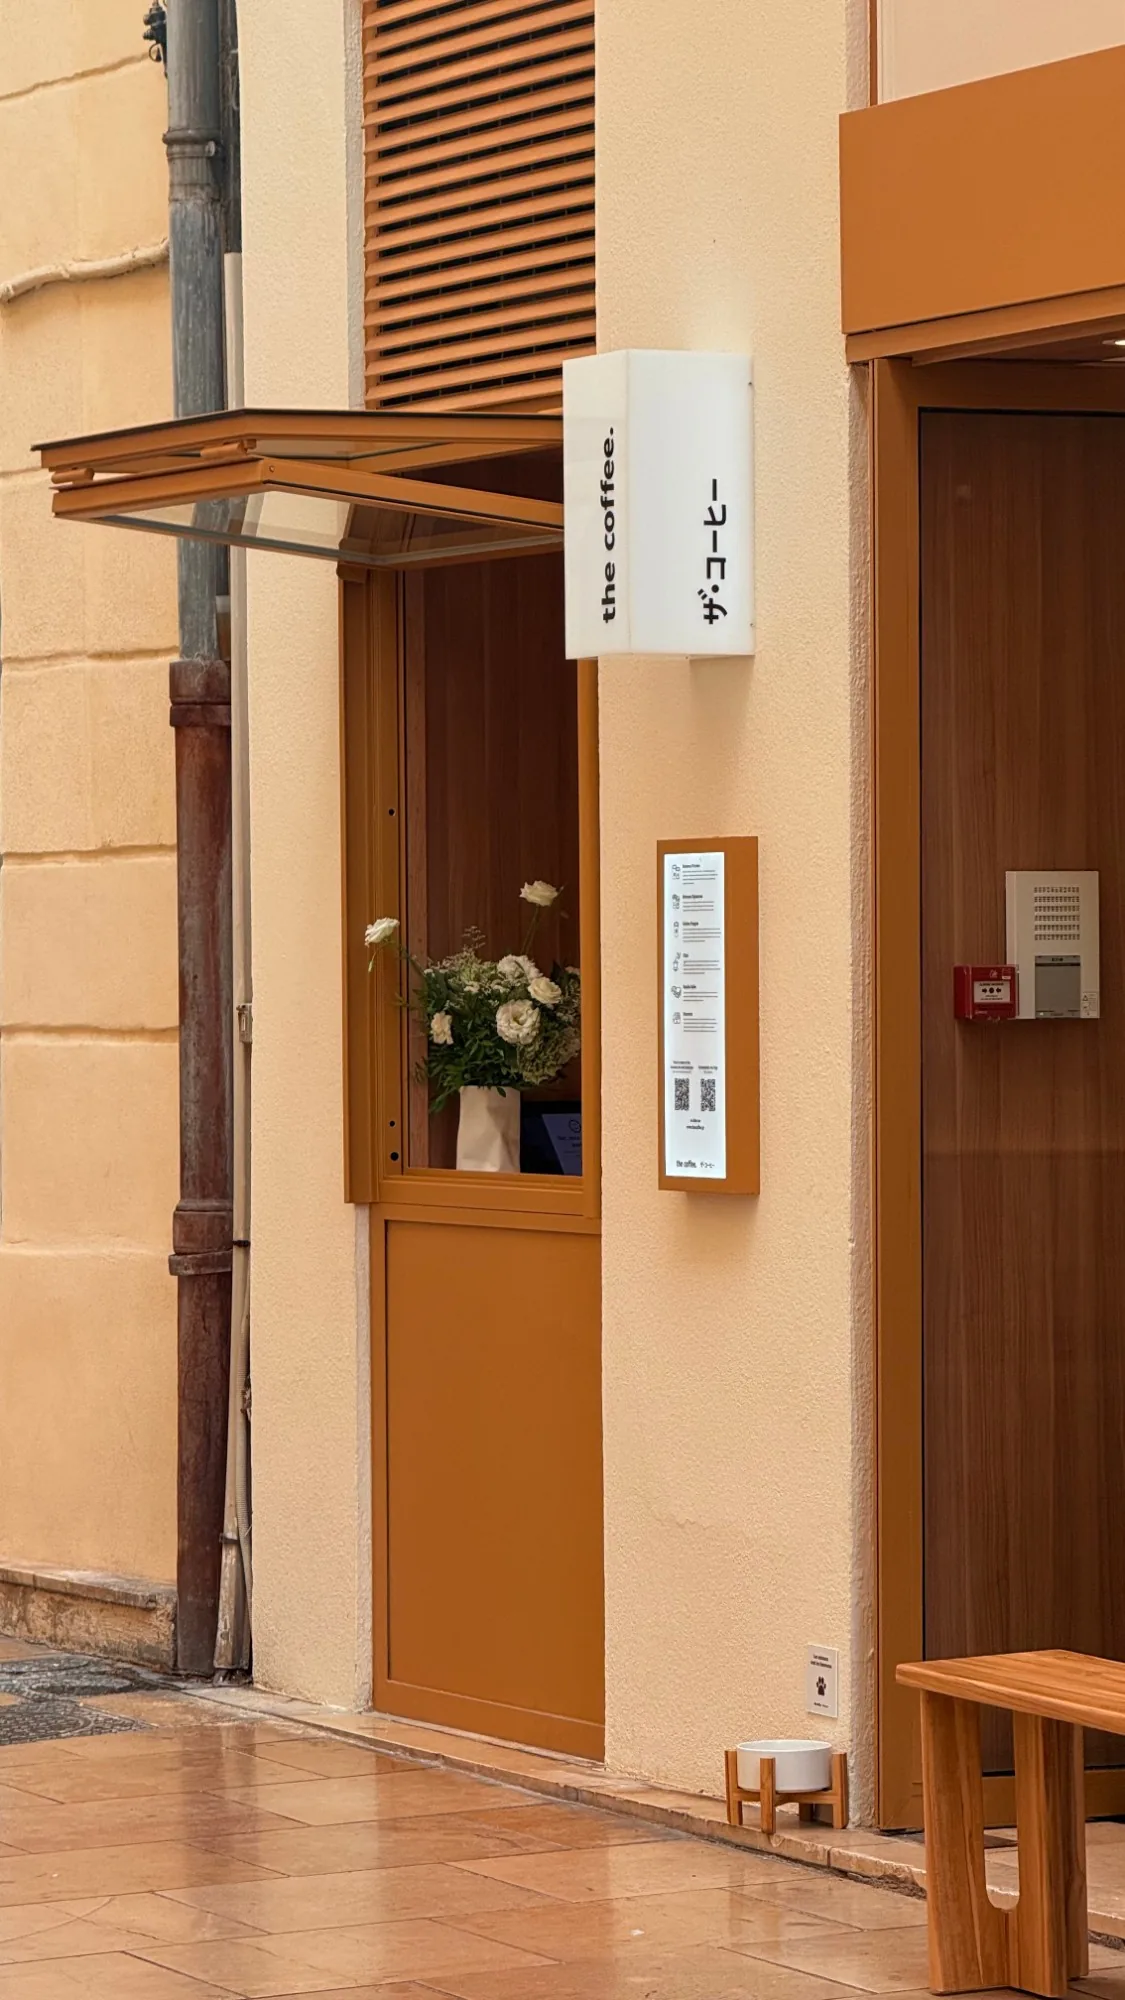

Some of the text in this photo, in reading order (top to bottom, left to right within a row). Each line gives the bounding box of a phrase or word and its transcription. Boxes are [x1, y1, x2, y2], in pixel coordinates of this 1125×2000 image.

[600, 427, 616, 624] the coffee.
[697, 478, 728, 625] ザ・コーヒー
